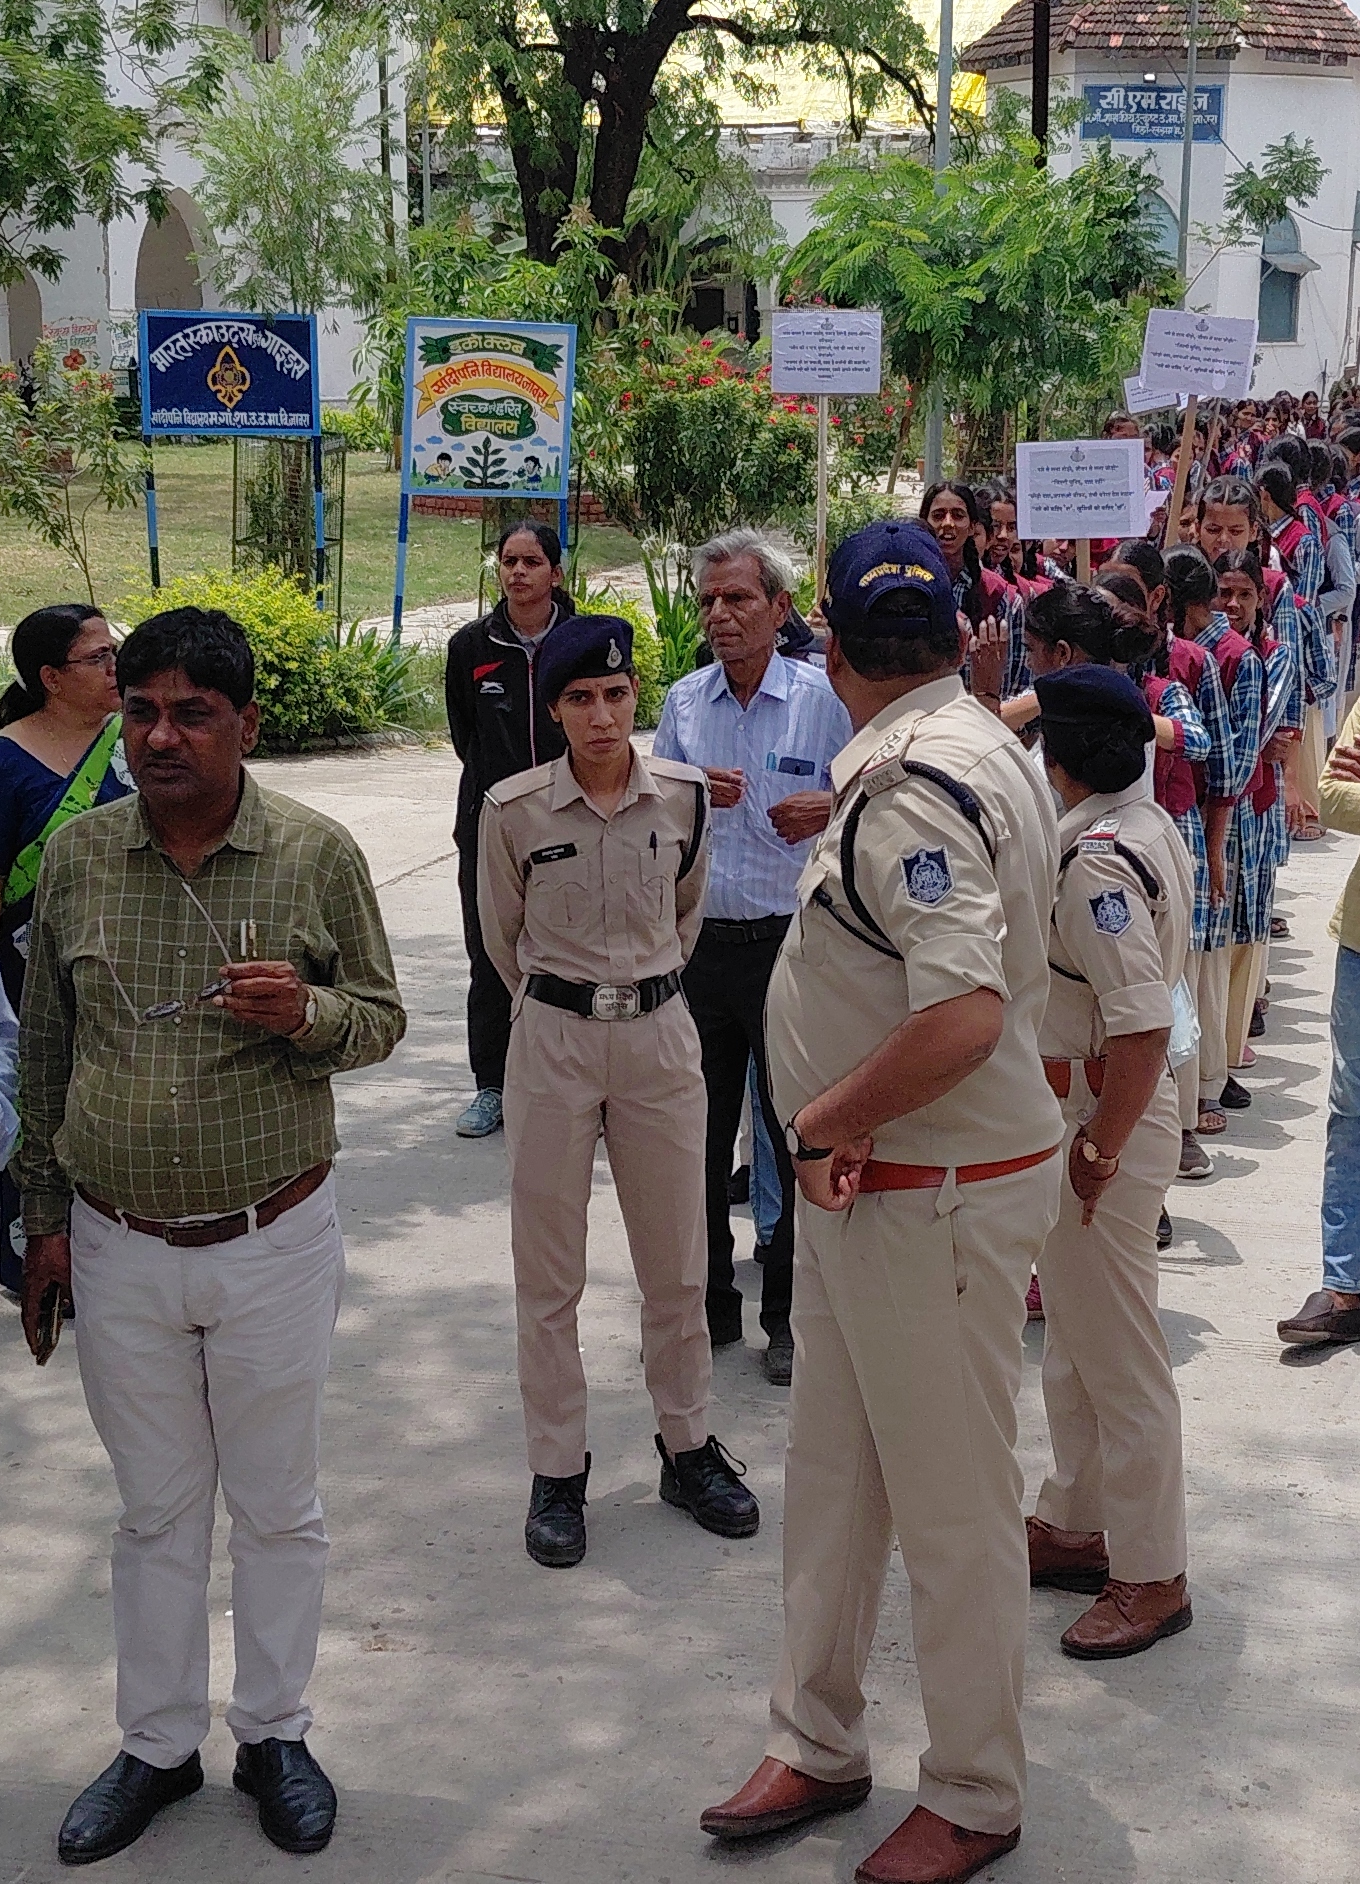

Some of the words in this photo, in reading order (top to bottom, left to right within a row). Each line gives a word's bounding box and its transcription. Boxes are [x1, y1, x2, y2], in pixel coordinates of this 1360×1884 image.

[149, 332, 193, 373] भारत
[430, 360, 481, 395] सांदीपनि
[481, 359, 525, 385] विद्यालय
[461, 414, 520, 435] विद्यालय
[903, 564, 936, 582] पुलिस
